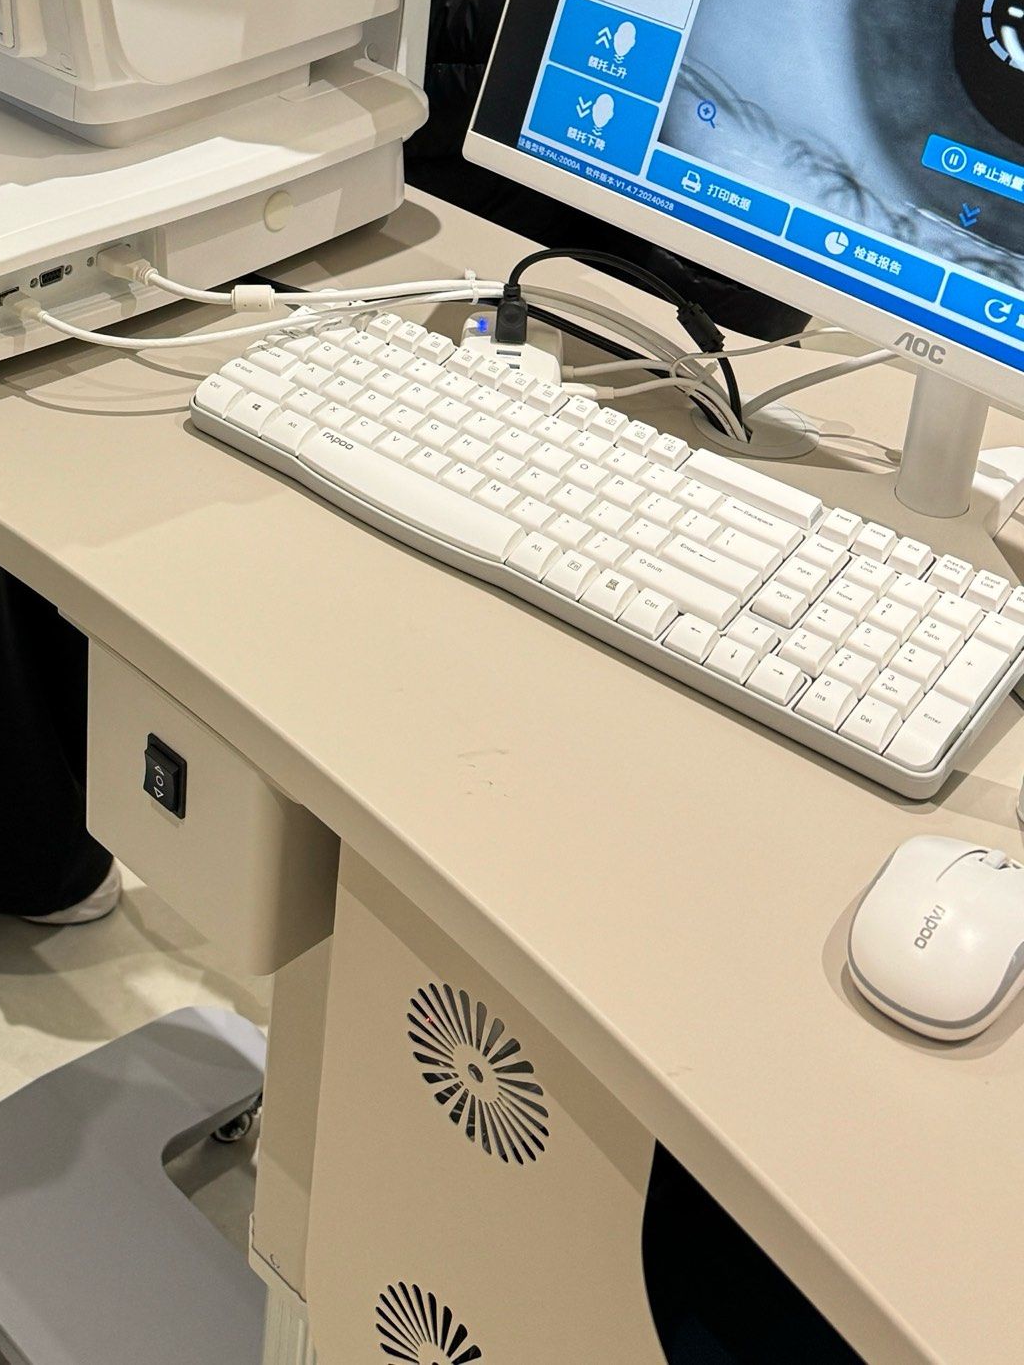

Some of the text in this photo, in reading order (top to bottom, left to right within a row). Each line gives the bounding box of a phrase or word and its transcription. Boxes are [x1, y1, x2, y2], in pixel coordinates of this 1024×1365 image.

[973, 160, 1024, 192] 停止测量
[707, 183, 751, 212] 打印数据
[853, 245, 903, 276] 检查报告
[893, 331, 947, 365] AOC
[531, 544, 542, 552] Alt
[646, 562, 663, 573] Shift
[644, 599, 659, 609] Ctrl
[860, 714, 872, 724] Del
